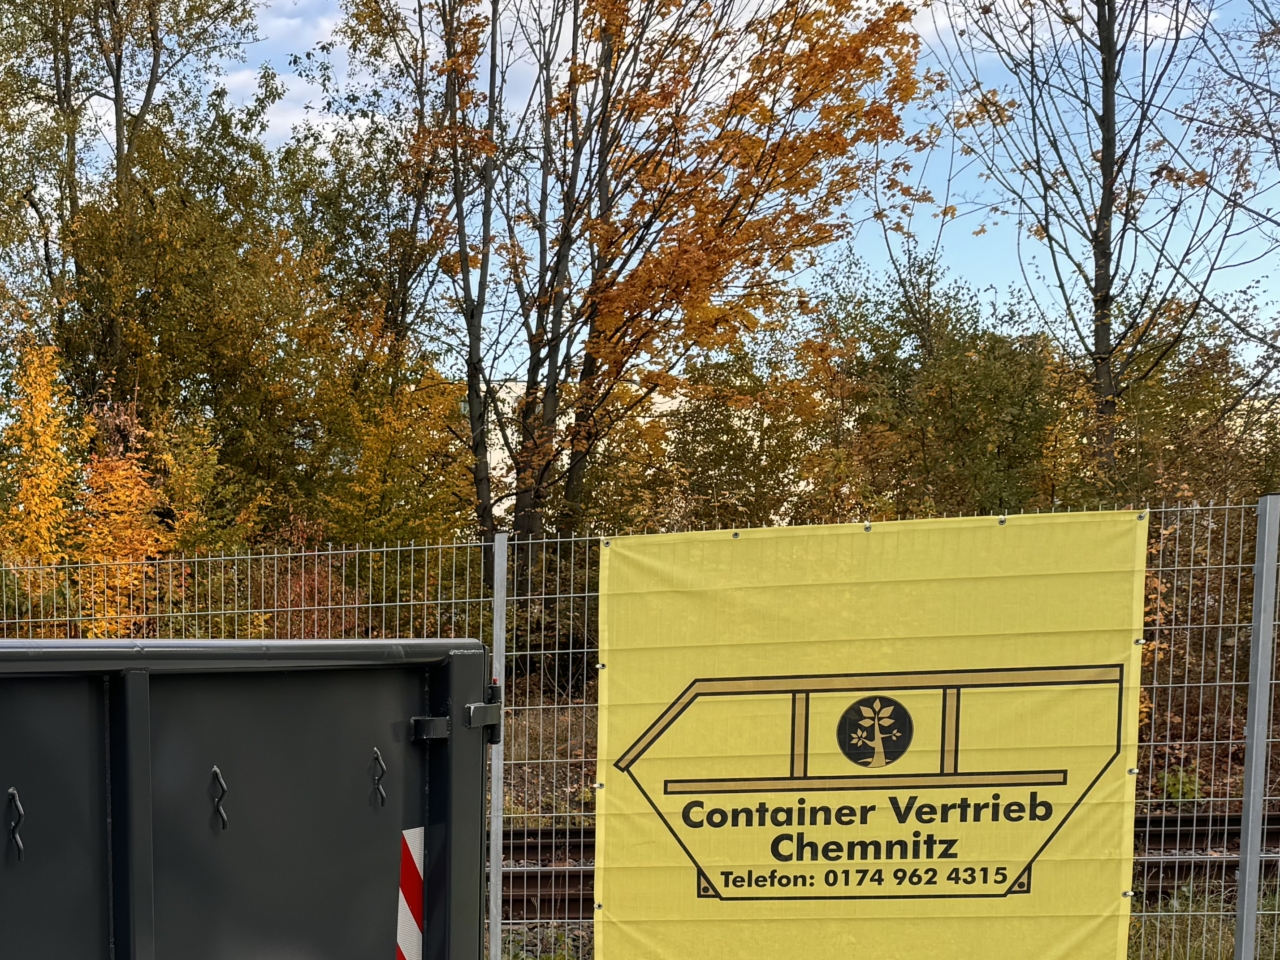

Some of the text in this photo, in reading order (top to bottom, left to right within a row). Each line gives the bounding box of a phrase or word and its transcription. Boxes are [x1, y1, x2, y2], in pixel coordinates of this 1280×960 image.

[681, 791, 1053, 829] Container Vertrieb
[770, 830, 959, 862] Chemnitz
[720, 866, 1008, 889] Telefon: 0174 962 4315
